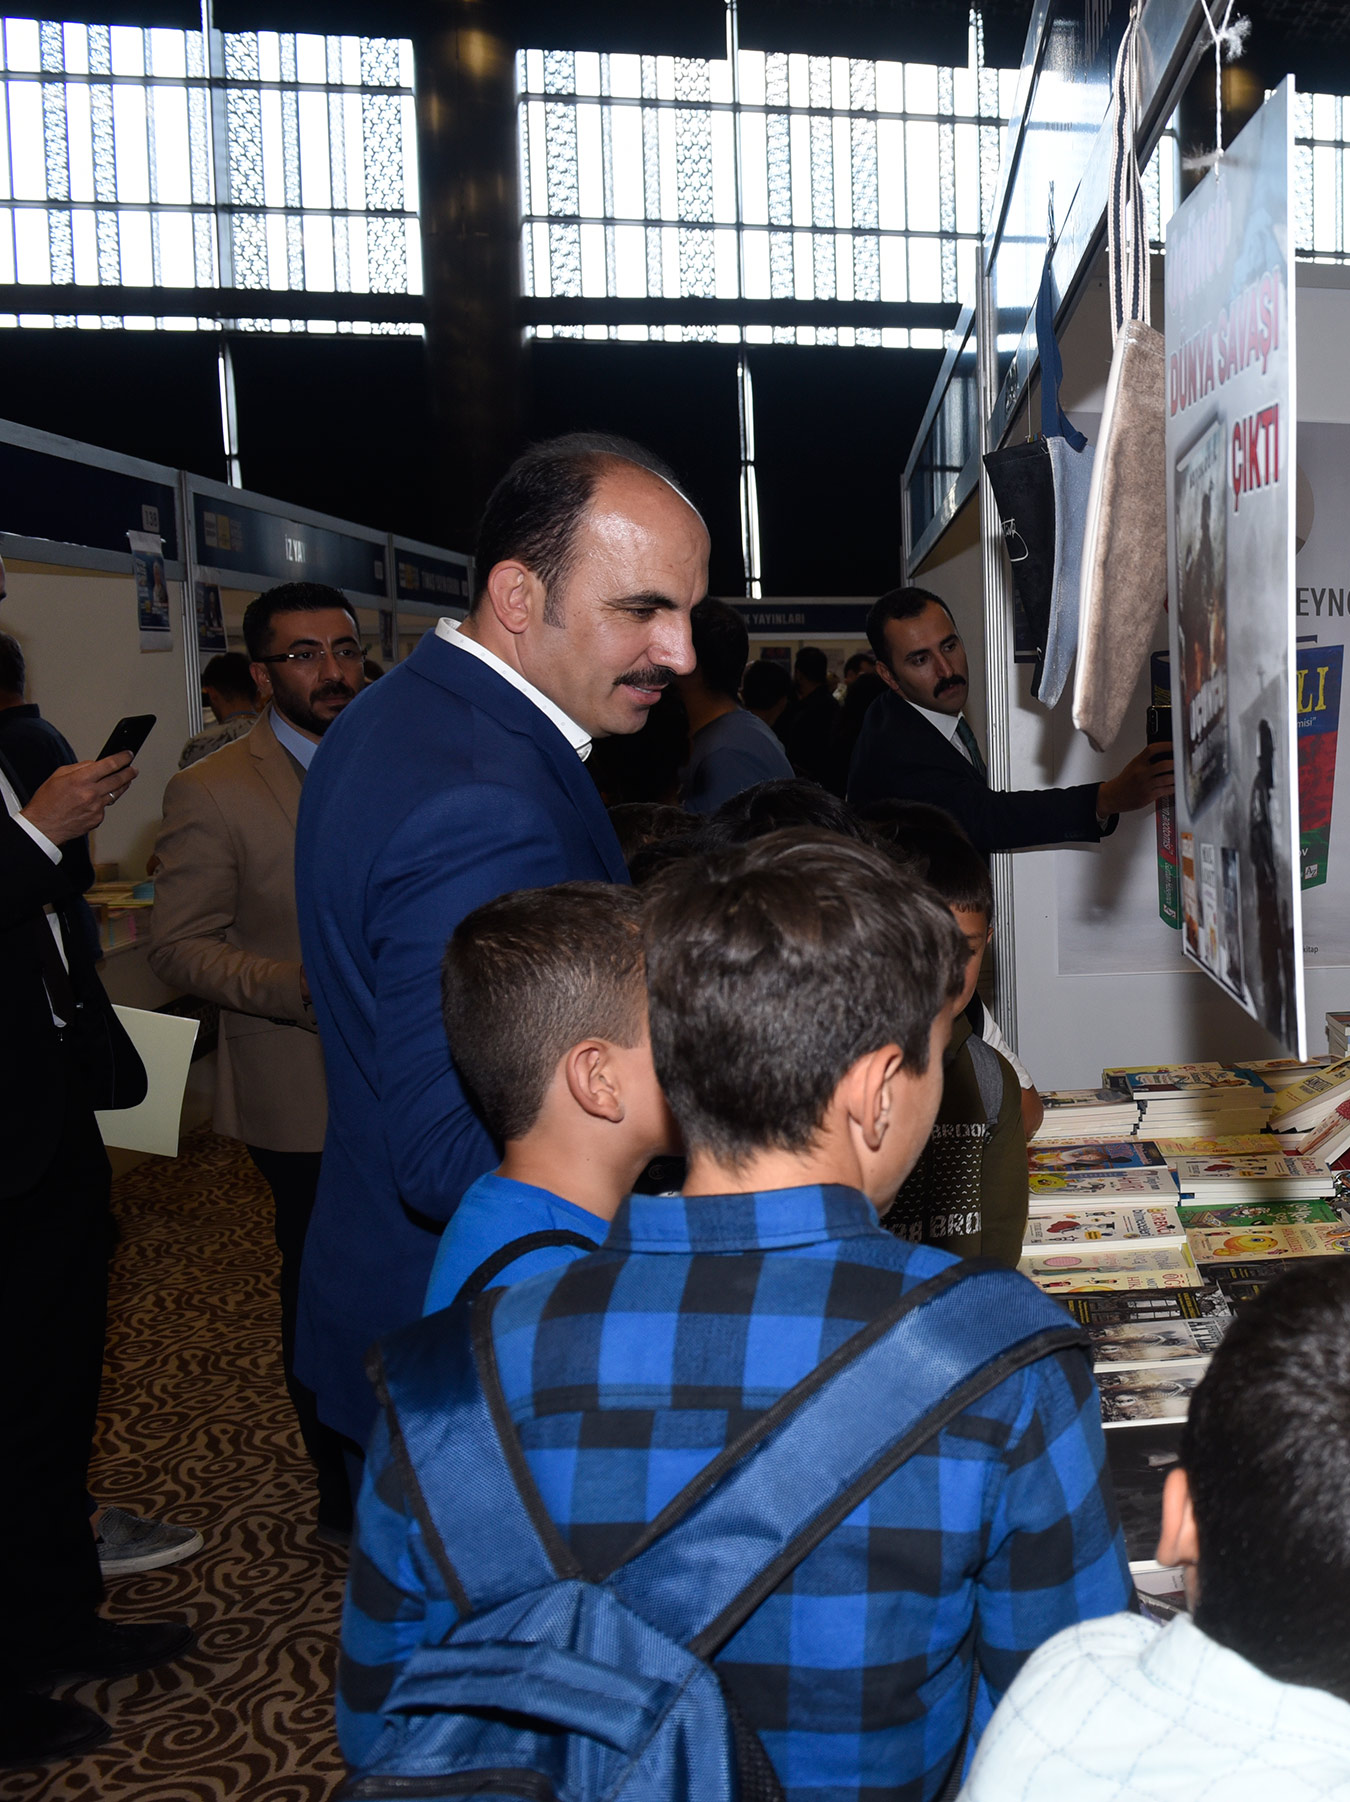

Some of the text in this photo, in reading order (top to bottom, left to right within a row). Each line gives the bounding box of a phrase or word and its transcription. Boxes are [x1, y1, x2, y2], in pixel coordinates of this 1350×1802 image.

[1170, 268, 1280, 417] DÜNYA SAVAŞI
[1232, 402, 1280, 514] ÇIKTI
[752, 613, 805, 625] YAYINLARI
